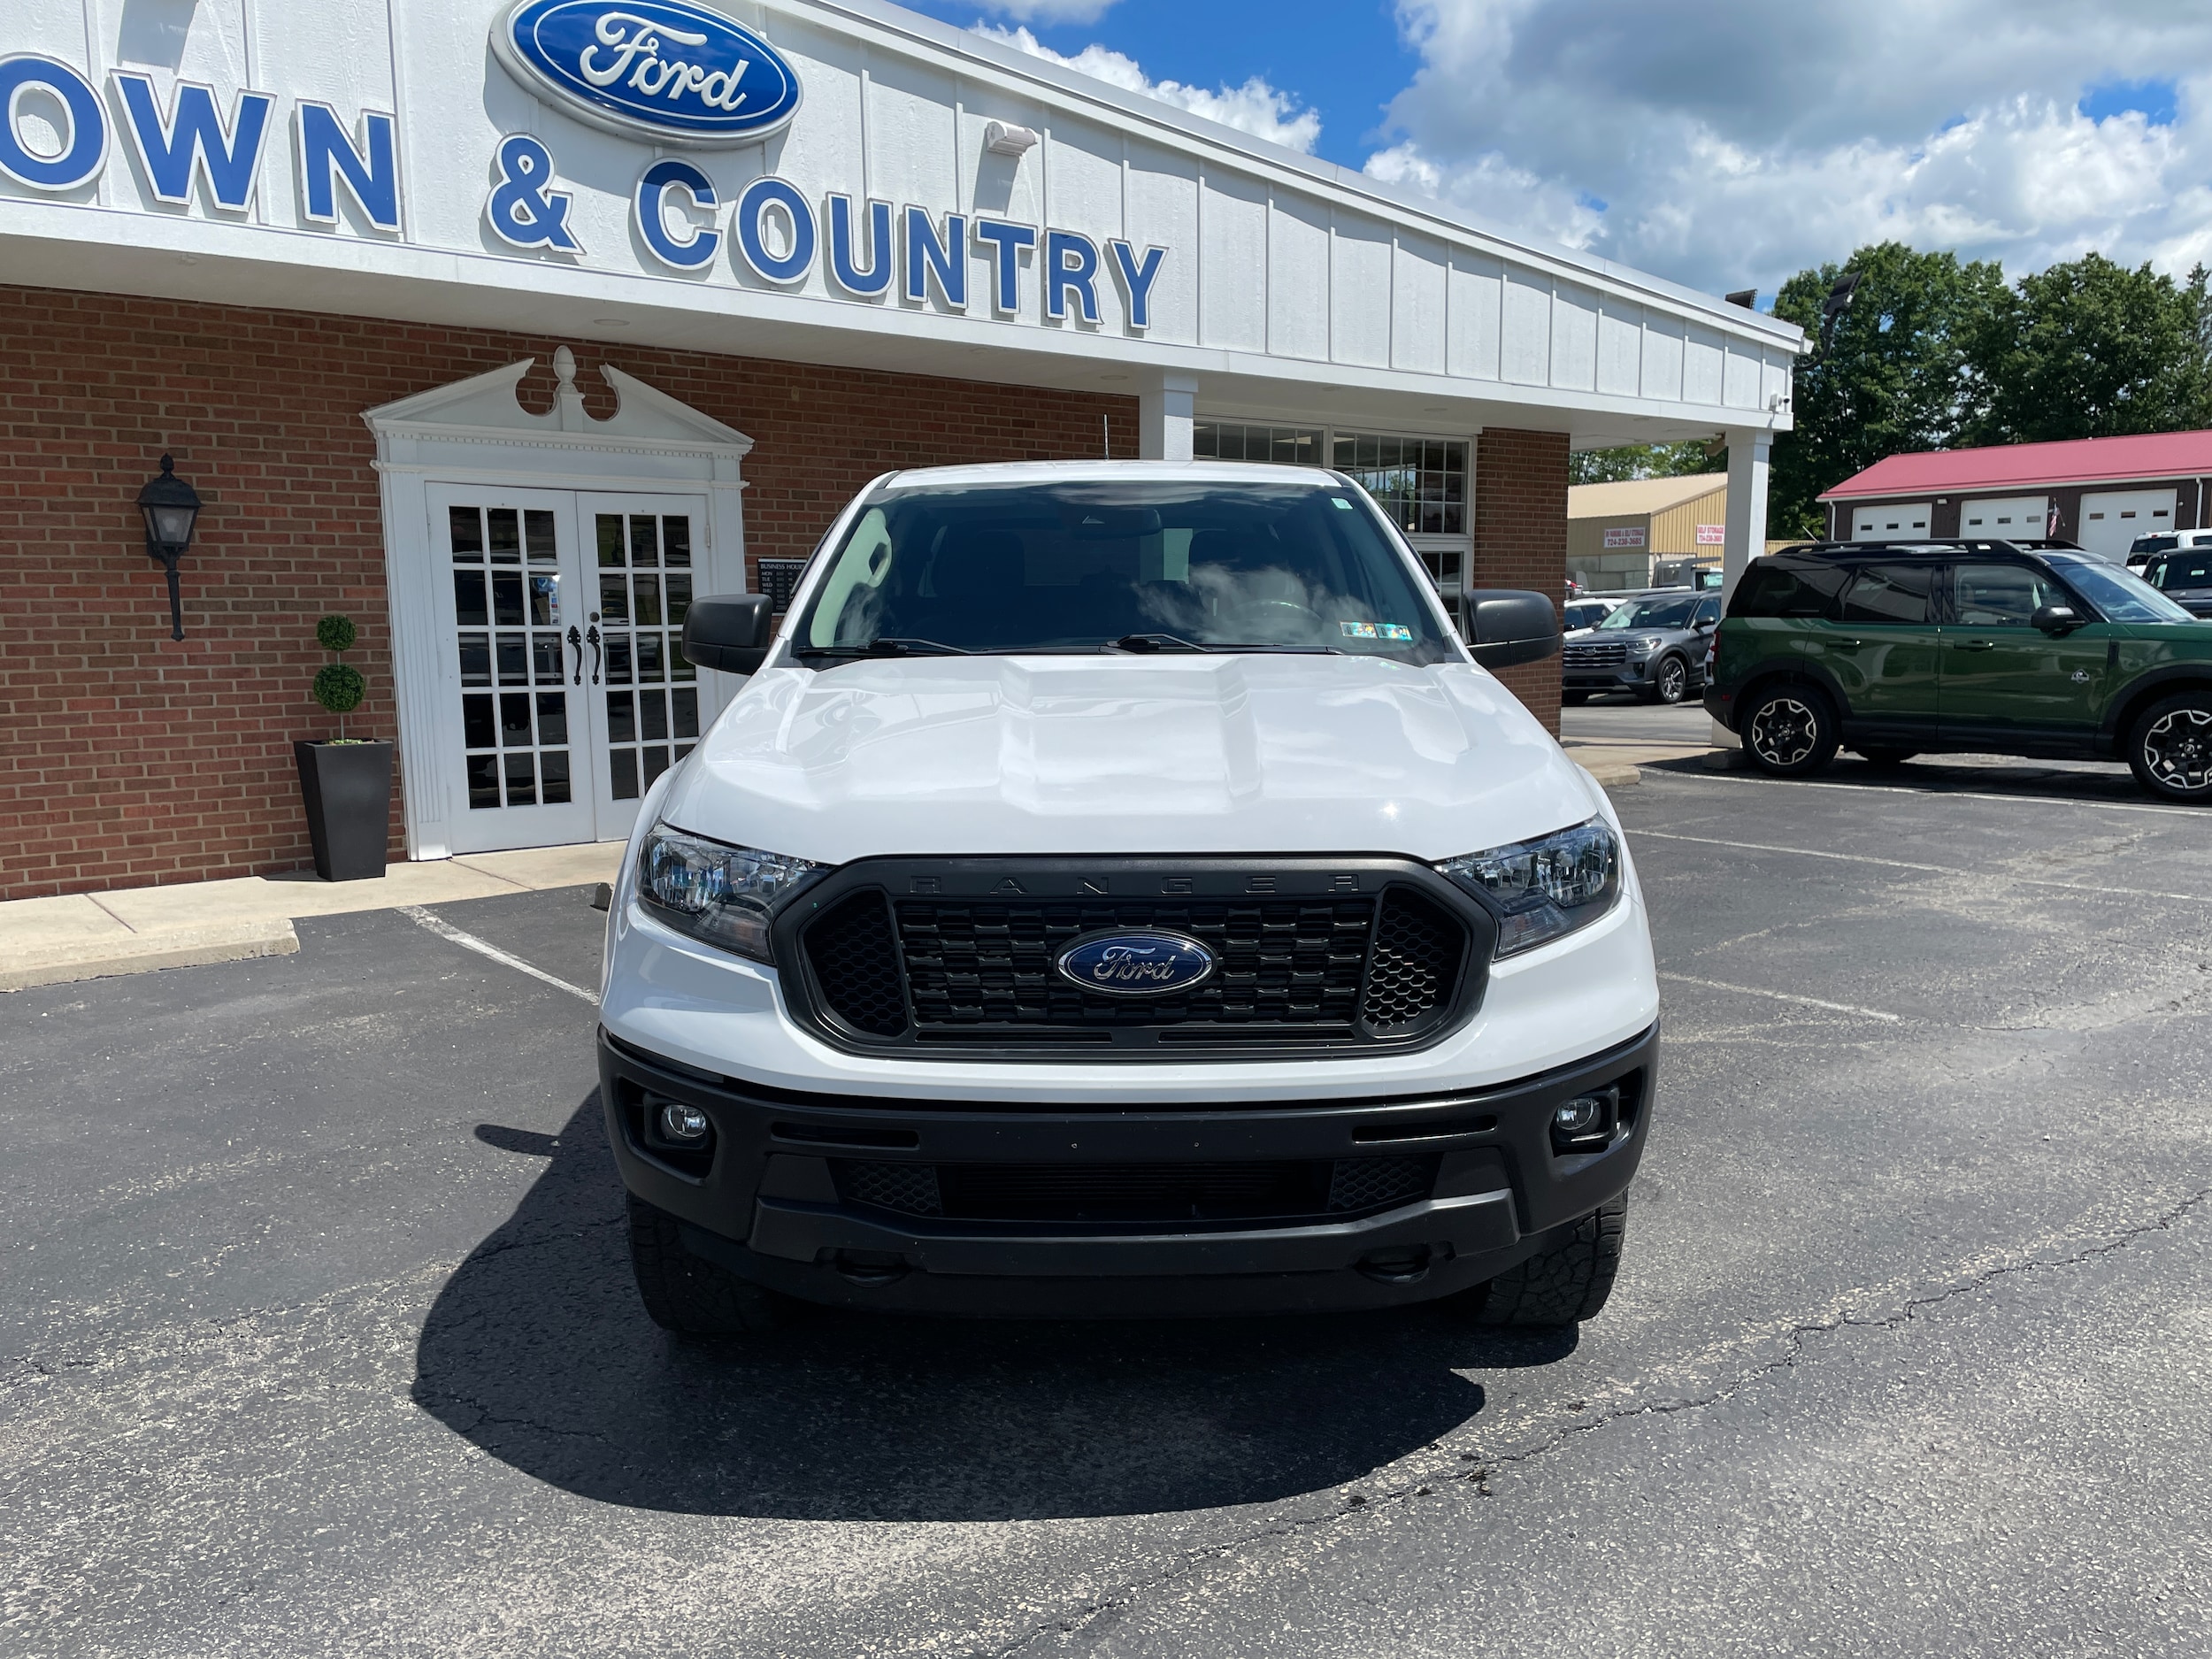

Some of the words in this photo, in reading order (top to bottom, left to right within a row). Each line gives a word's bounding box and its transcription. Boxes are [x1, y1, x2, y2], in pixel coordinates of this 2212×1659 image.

[579, 11, 750, 113] Ford
[486, 131, 588, 256] &
[634, 157, 1170, 331] COUNTRY
[910, 873, 1359, 895] RANGER
[1094, 945, 1178, 980] Ford
